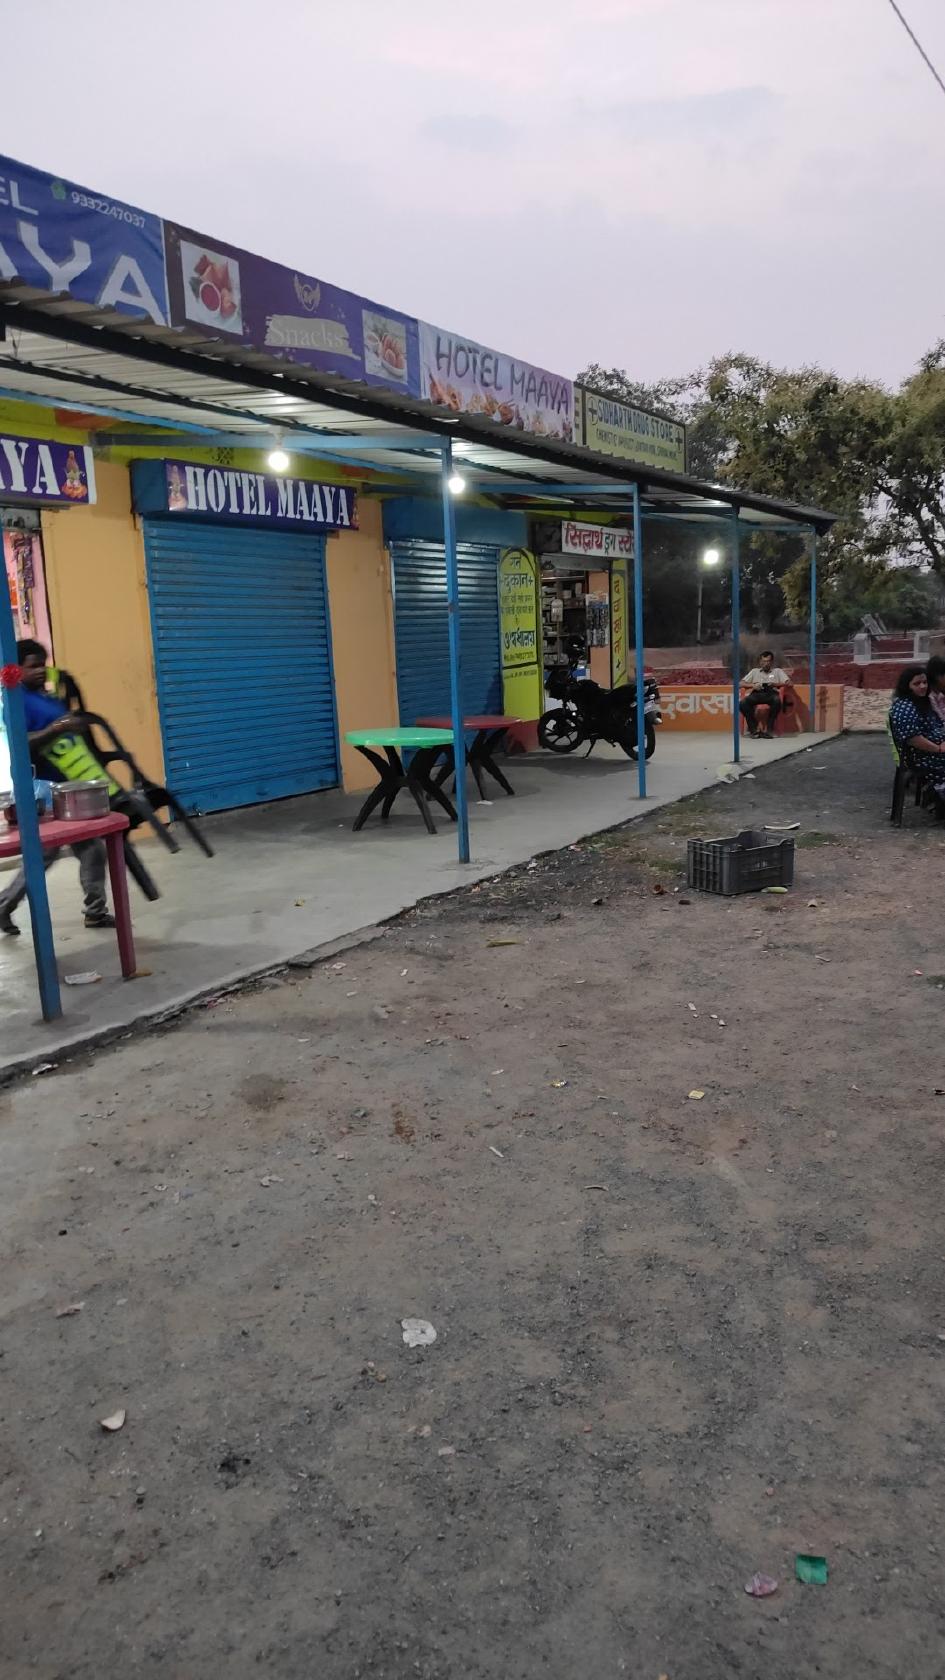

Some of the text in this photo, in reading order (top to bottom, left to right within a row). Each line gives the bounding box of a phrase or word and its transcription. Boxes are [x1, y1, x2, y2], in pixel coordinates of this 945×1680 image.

[71, 191, 146, 230] 9332247037
[0, 221, 167, 327] YA
[270, 317, 344, 348] Snacks
[436, 335, 503, 390] HOTEL
[511, 363, 570, 414] MAAYA
[650, 417, 674, 443] STORE
[0, 438, 61, 495] YA
[184, 465, 350, 526] HOTEL MAAYA
